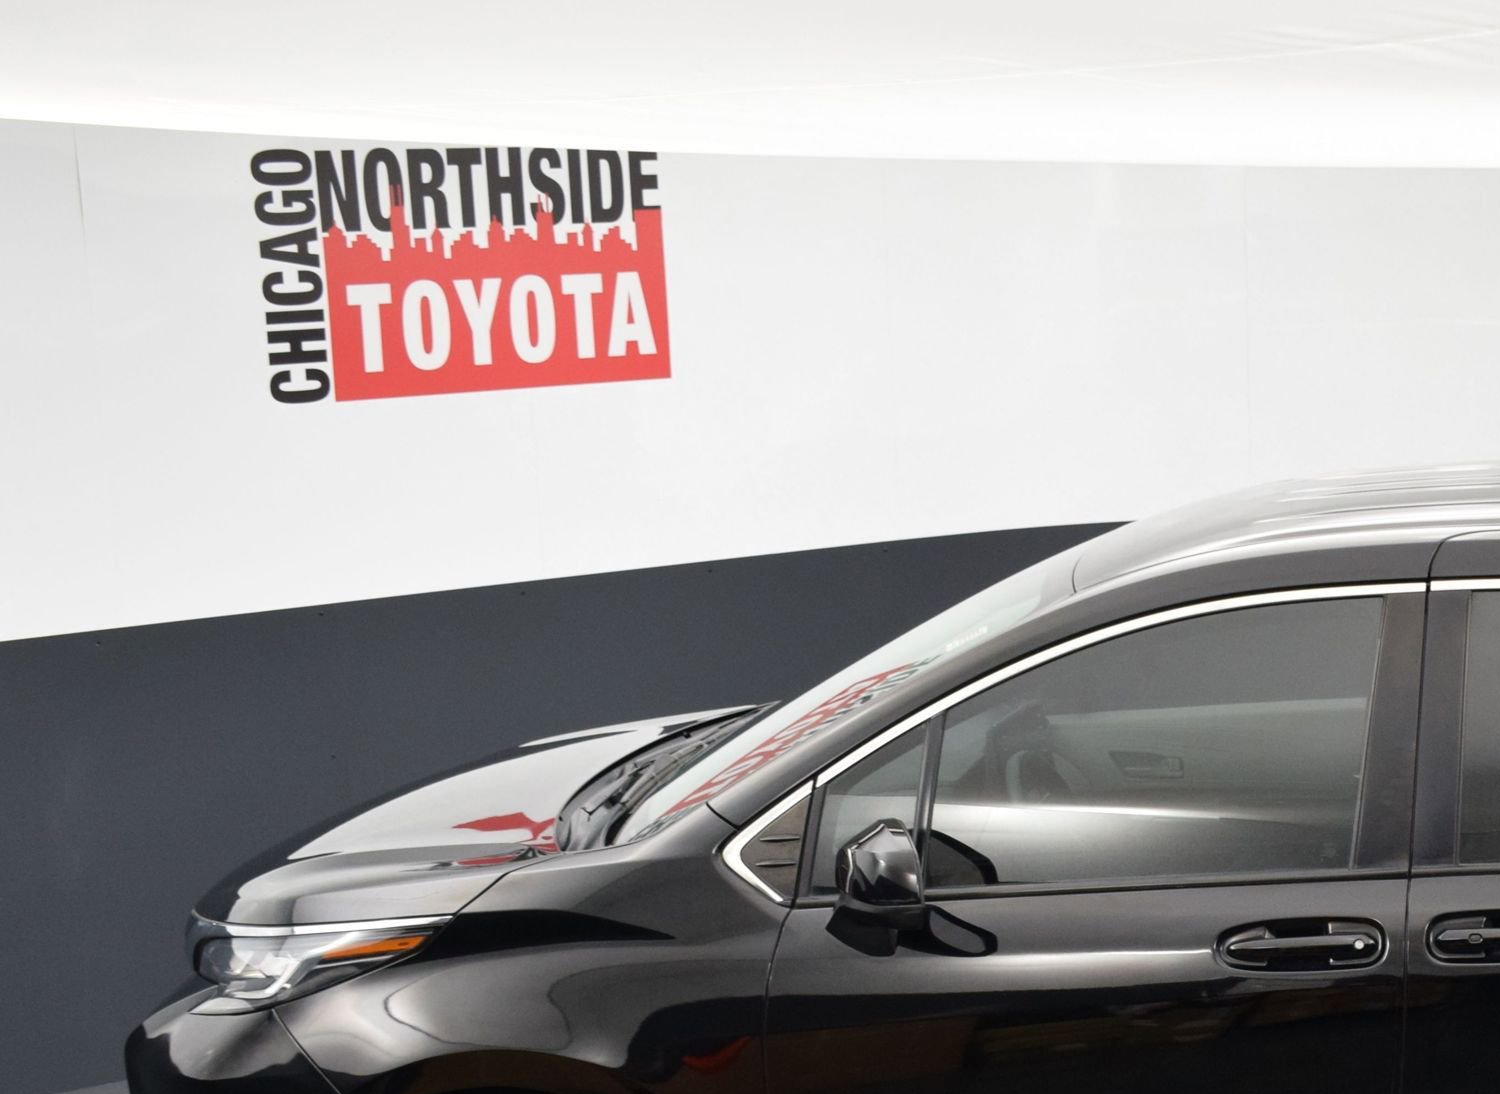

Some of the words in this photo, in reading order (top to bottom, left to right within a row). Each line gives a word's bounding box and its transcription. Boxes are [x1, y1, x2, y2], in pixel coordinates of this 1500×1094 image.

[314, 147, 662, 233] NORTHSIDE
[251, 148, 331, 404] CHICAGO
[345, 271, 658, 374] TOYOTA
